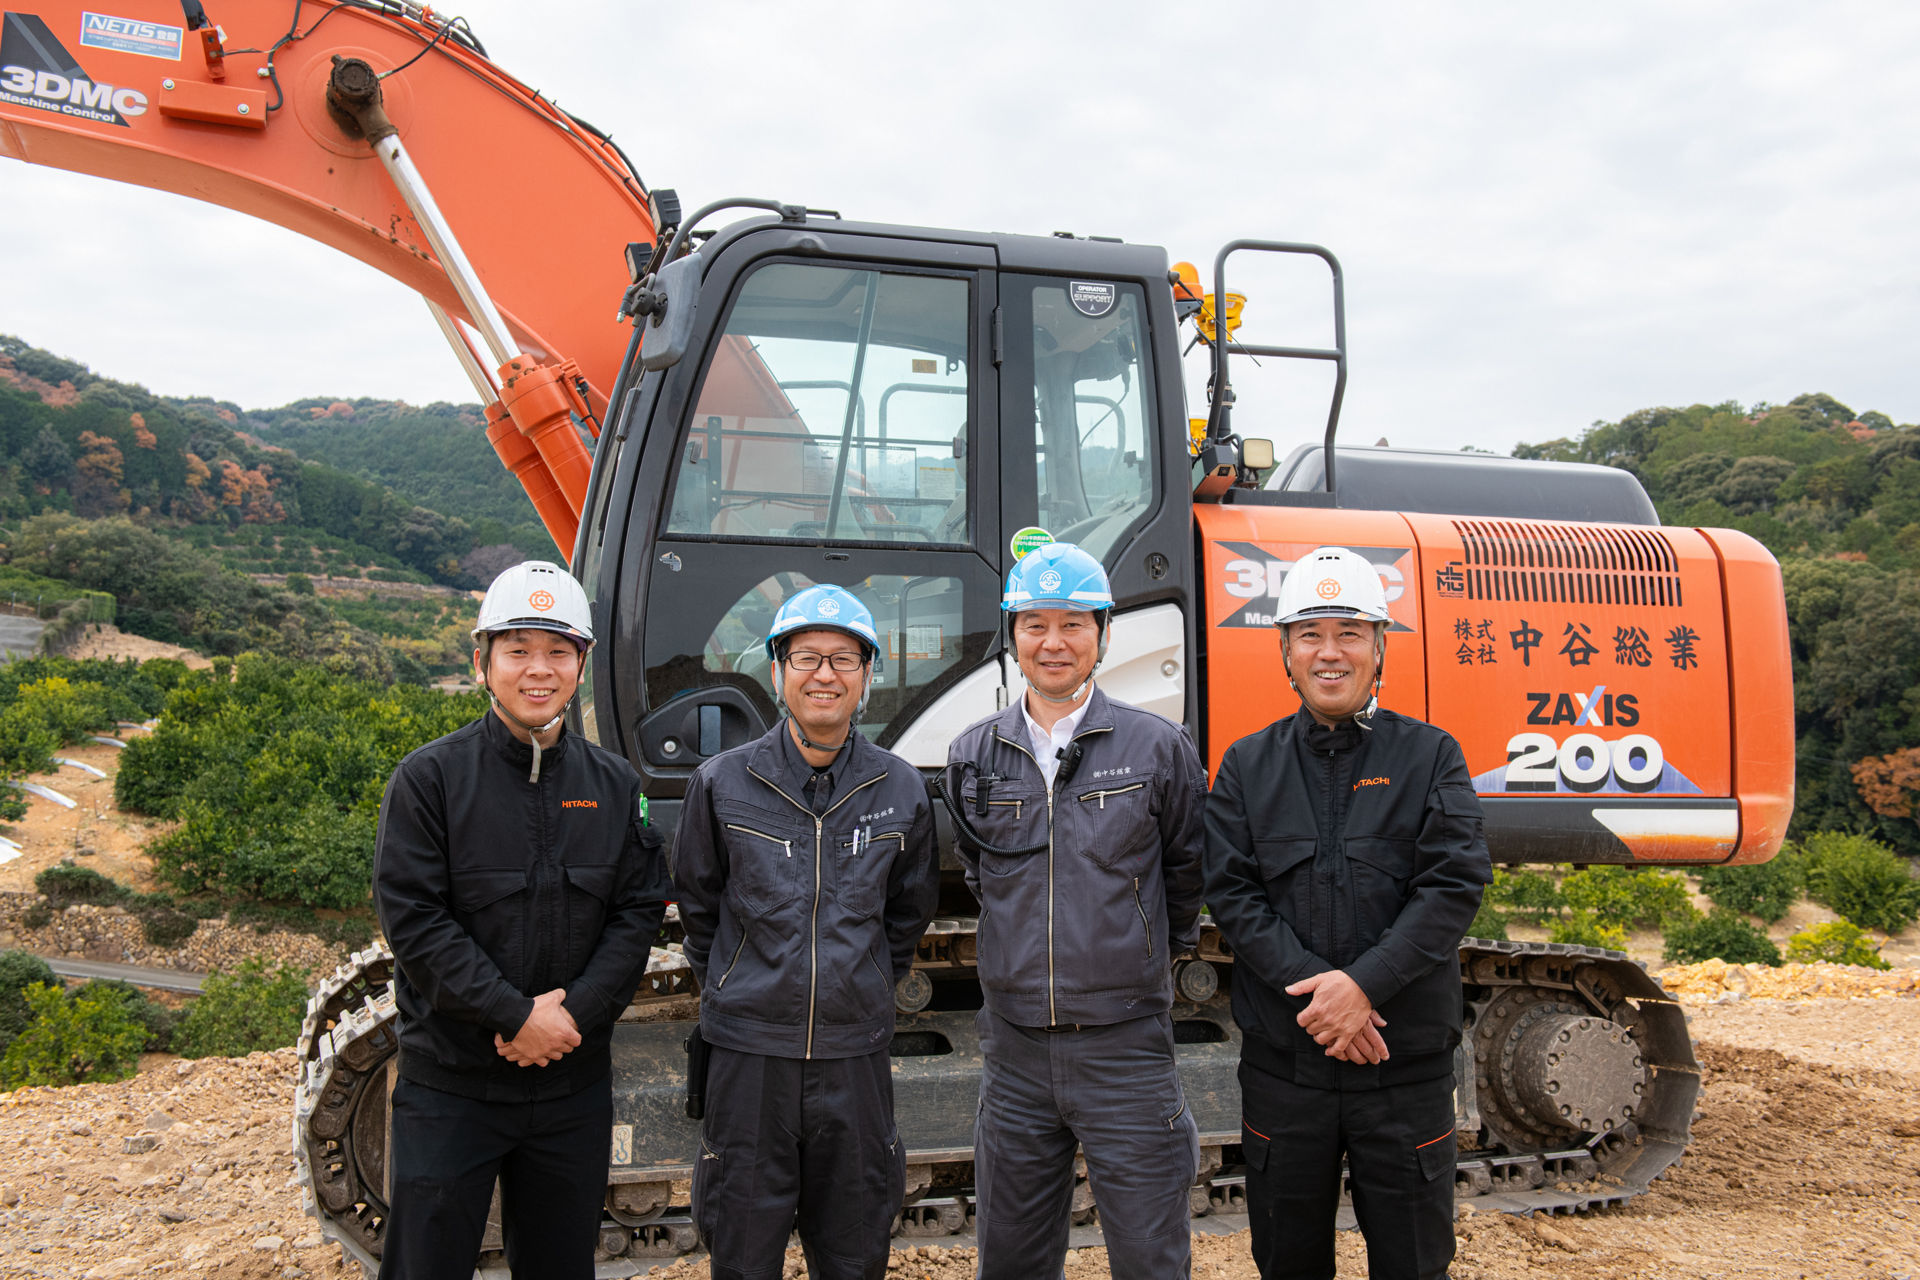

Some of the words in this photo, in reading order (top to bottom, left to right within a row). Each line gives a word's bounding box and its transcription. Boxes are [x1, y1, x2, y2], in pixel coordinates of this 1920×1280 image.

[88, 15, 156, 38] NETIS
[1, 65, 148, 116] 3DMC
[0, 92, 60, 111] Machine
[61, 104, 116, 123] Control
[1074, 293, 1112, 303] SUPPORT
[1078, 285, 1107, 293] OPERATOR
[1509, 618, 1701, 671] 中谷総業
[1526, 685, 1640, 727] ZAXIS
[1505, 733, 1663, 793] 200
[562, 800, 598, 808] HITACHI
